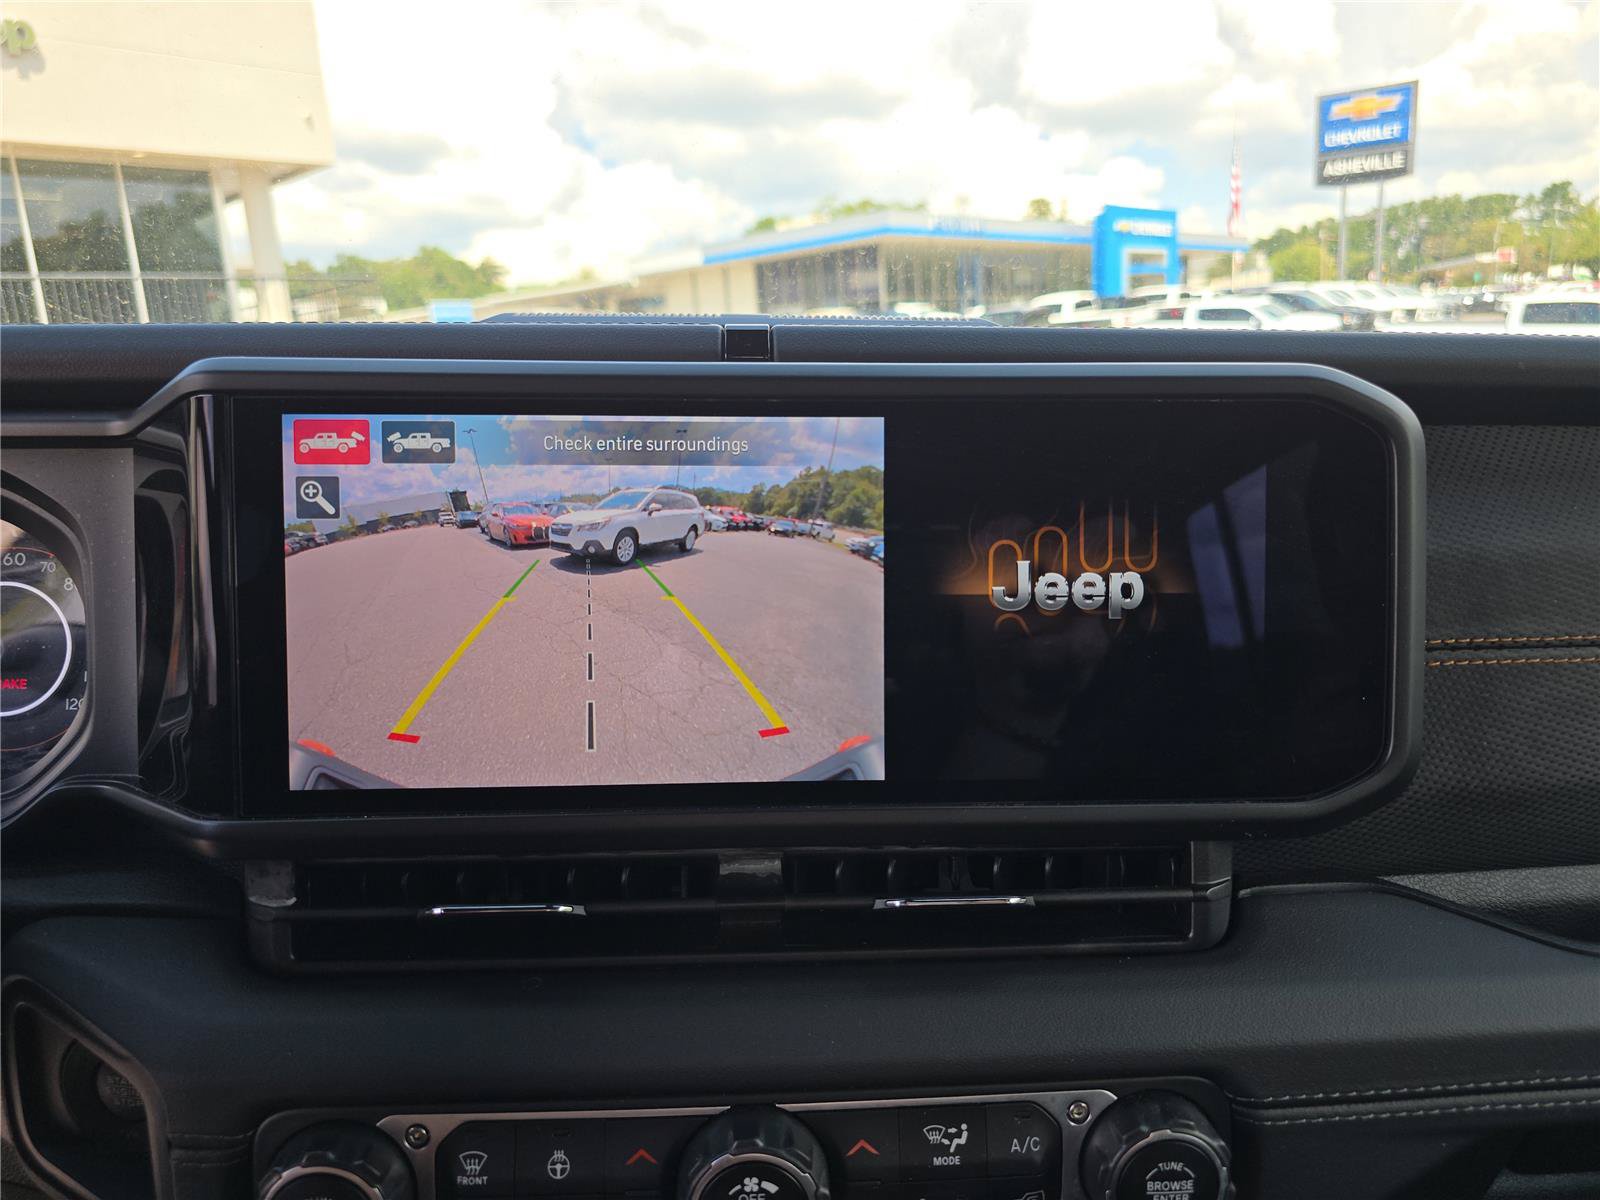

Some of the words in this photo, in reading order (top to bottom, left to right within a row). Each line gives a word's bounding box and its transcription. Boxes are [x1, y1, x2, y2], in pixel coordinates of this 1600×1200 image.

[1324, 122, 1404, 148] CHEVROLET
[1323, 150, 1406, 178] ASHEVILLE
[543, 435, 593, 451] Check
[596, 436, 643, 451] entire
[646, 437, 749, 455] surroundings
[3, 552, 26, 566] 60
[40, 561, 56, 573] 70
[63, 577, 78, 591] 8
[991, 560, 1145, 620] Jeep
[0, 678, 28, 690] AKE
[1010, 1136, 1041, 1153] A/C
[933, 1156, 961, 1166] MODE
[1157, 1161, 1185, 1172] TUNE
[456, 1175, 488, 1186] FRONT
[1146, 1179, 1194, 1192] BROWSE
